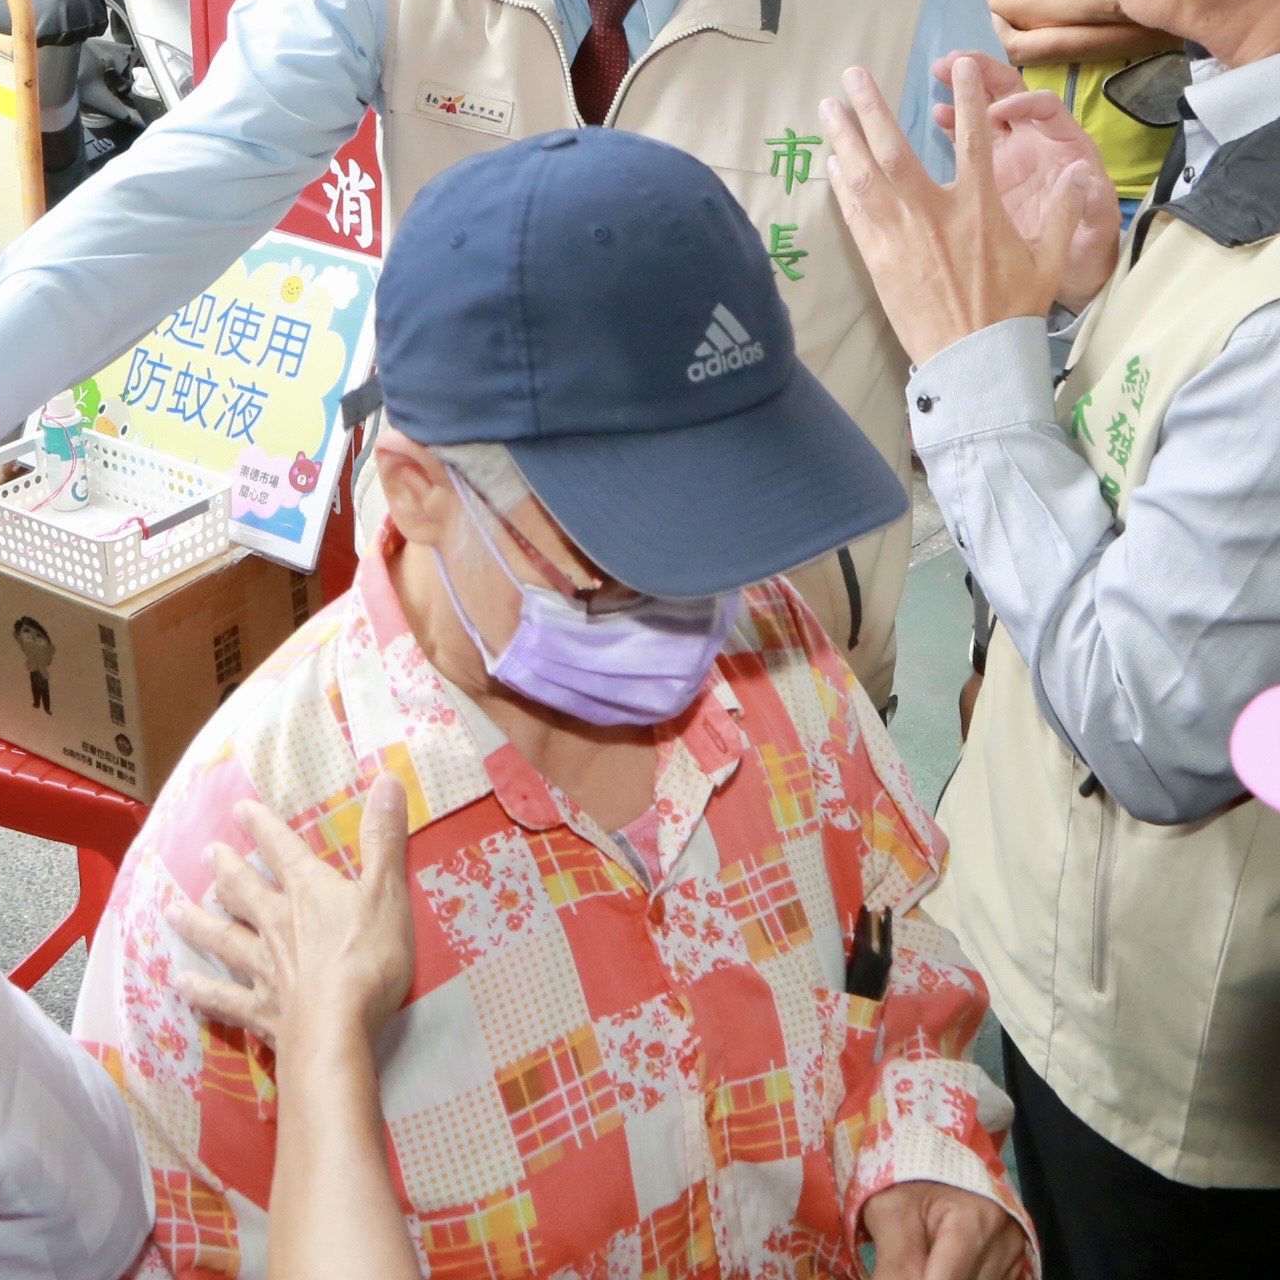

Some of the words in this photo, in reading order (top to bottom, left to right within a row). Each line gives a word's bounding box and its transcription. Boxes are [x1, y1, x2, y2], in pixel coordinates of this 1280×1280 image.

[321, 157, 376, 249] 消
[764, 127, 823, 282] 市長
[152, 293, 312, 379] 迎使用
[687, 341, 765, 383] adidas
[125, 347, 269, 445] 防蚊液
[238, 484, 269, 505] 關心您
[239, 464, 280, 489] 崇德市場
